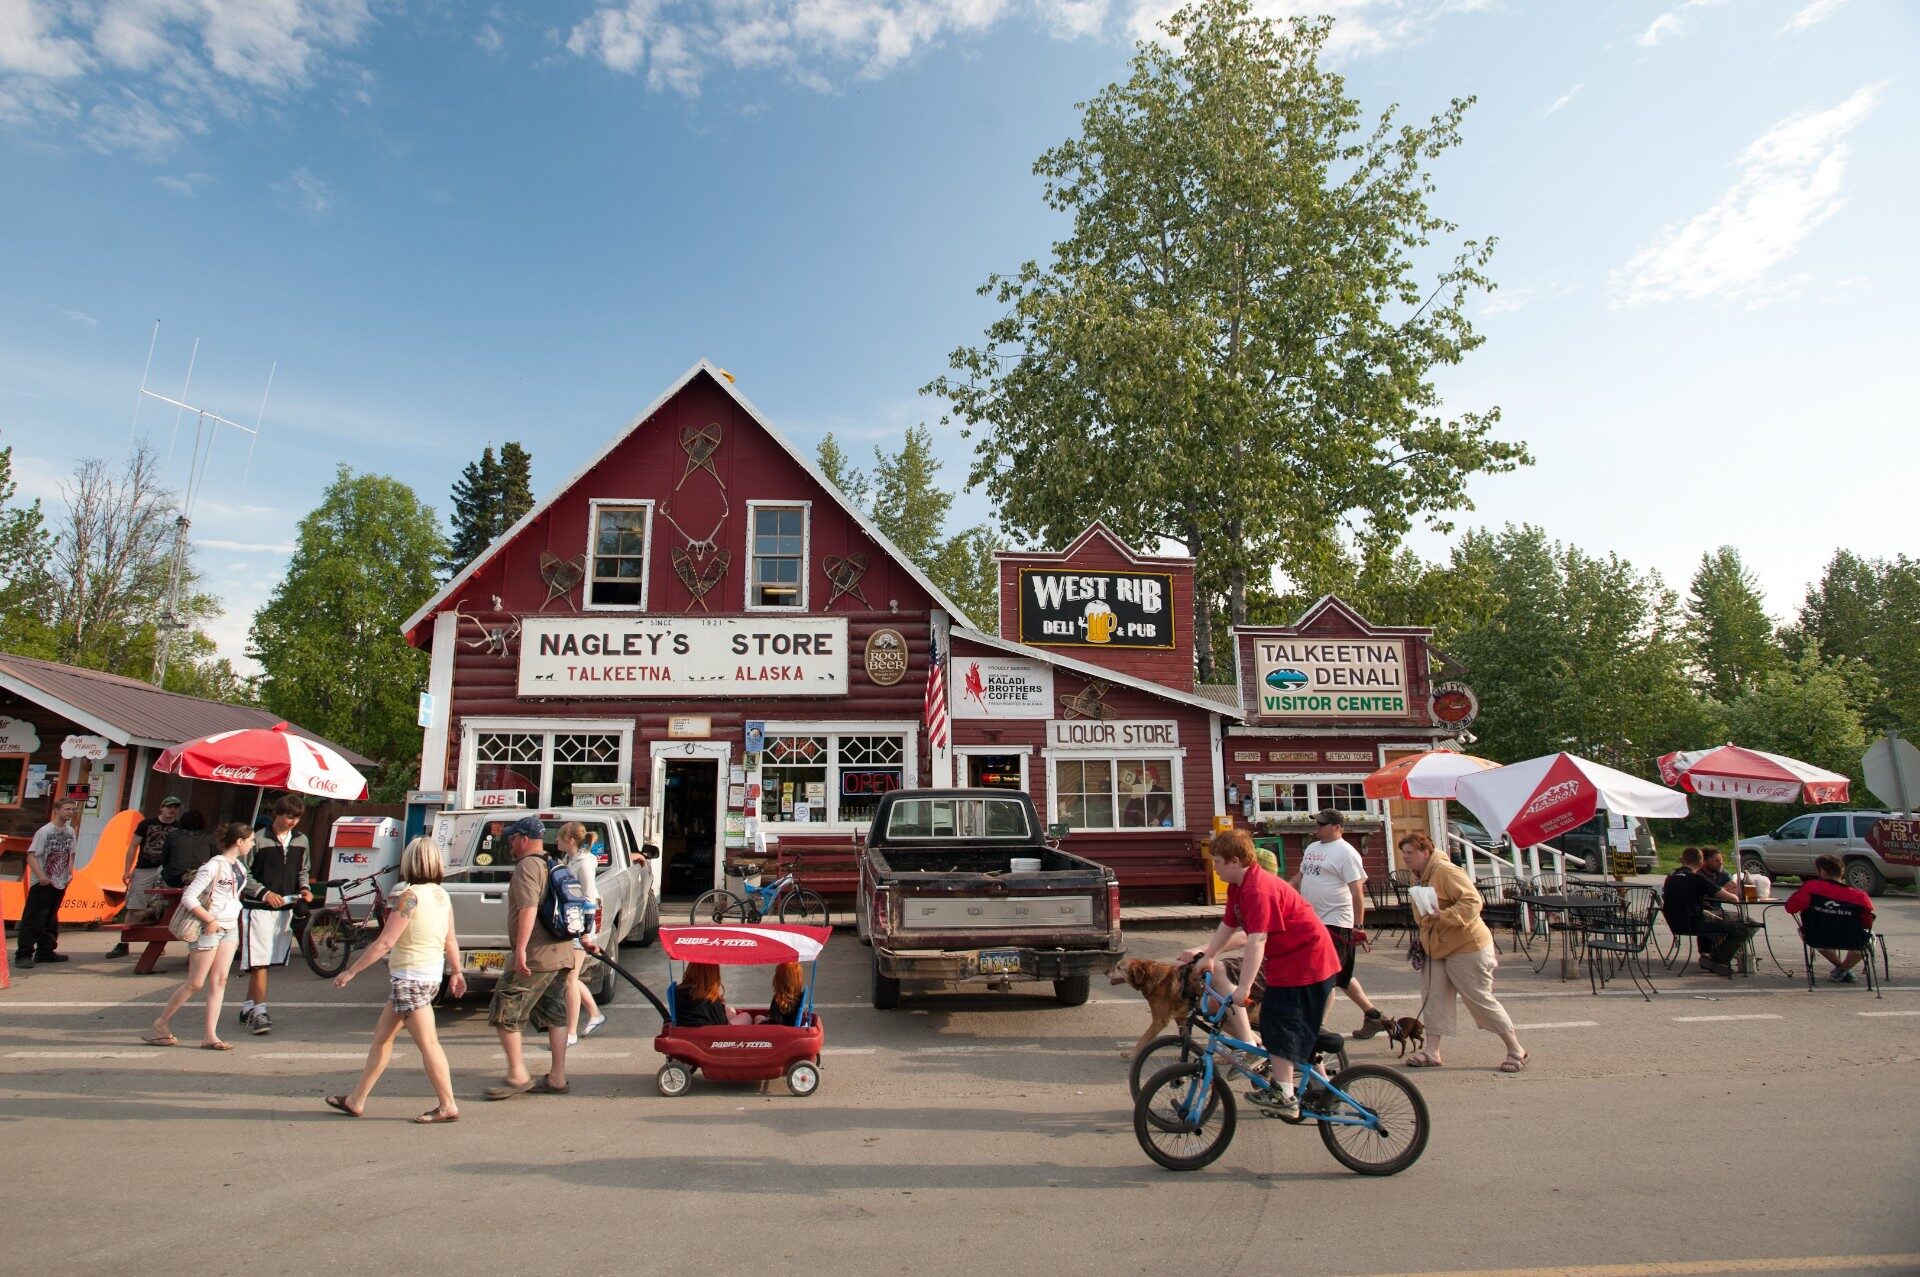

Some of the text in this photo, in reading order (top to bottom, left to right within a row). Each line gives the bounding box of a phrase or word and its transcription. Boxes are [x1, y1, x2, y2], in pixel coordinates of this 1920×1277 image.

[1032, 575, 1162, 614] WEST RIB
[1043, 620, 1156, 638] DELI & PUB
[539, 630, 833, 656] NAGLEY'S STORE
[1261, 644, 1399, 663] TALKEETNA
[735, 665, 803, 681] ALASKA
[1315, 667, 1400, 686] DENALI
[988, 685, 1043, 693] BROTHERS
[988, 692, 1028, 700] COFFEE
[1264, 695, 1404, 712] VISITOR CENTER
[1056, 724, 1174, 744] LIQUOR STORE
[1237, 752, 1258, 760] FISHING
[1271, 752, 1314, 760] FLIGHTSEEING
[1327, 752, 1371, 760] JETBOAT TOURS
[212, 763, 260, 781] Coca-Cola
[308, 775, 338, 793] Coke
[844, 773, 899, 793] OPEN
[1756, 785, 1791, 798] Coca-Cola
[481, 794, 506, 806] ICE
[595, 793, 621, 805] ICE
[1527, 785, 1580, 813] ALASKAN
[384, 827, 400, 838] FdEx
[1879, 820, 1914, 833] WEST
[1891, 831, 1908, 841] PUB
[1883, 840, 1900, 849] OPEN
[338, 852, 368, 864] FedEx
[58, 899, 106, 910] UDSON AIR
[922, 905, 1076, 916] FORD
[675, 937, 759, 947] RADIO FLYER
